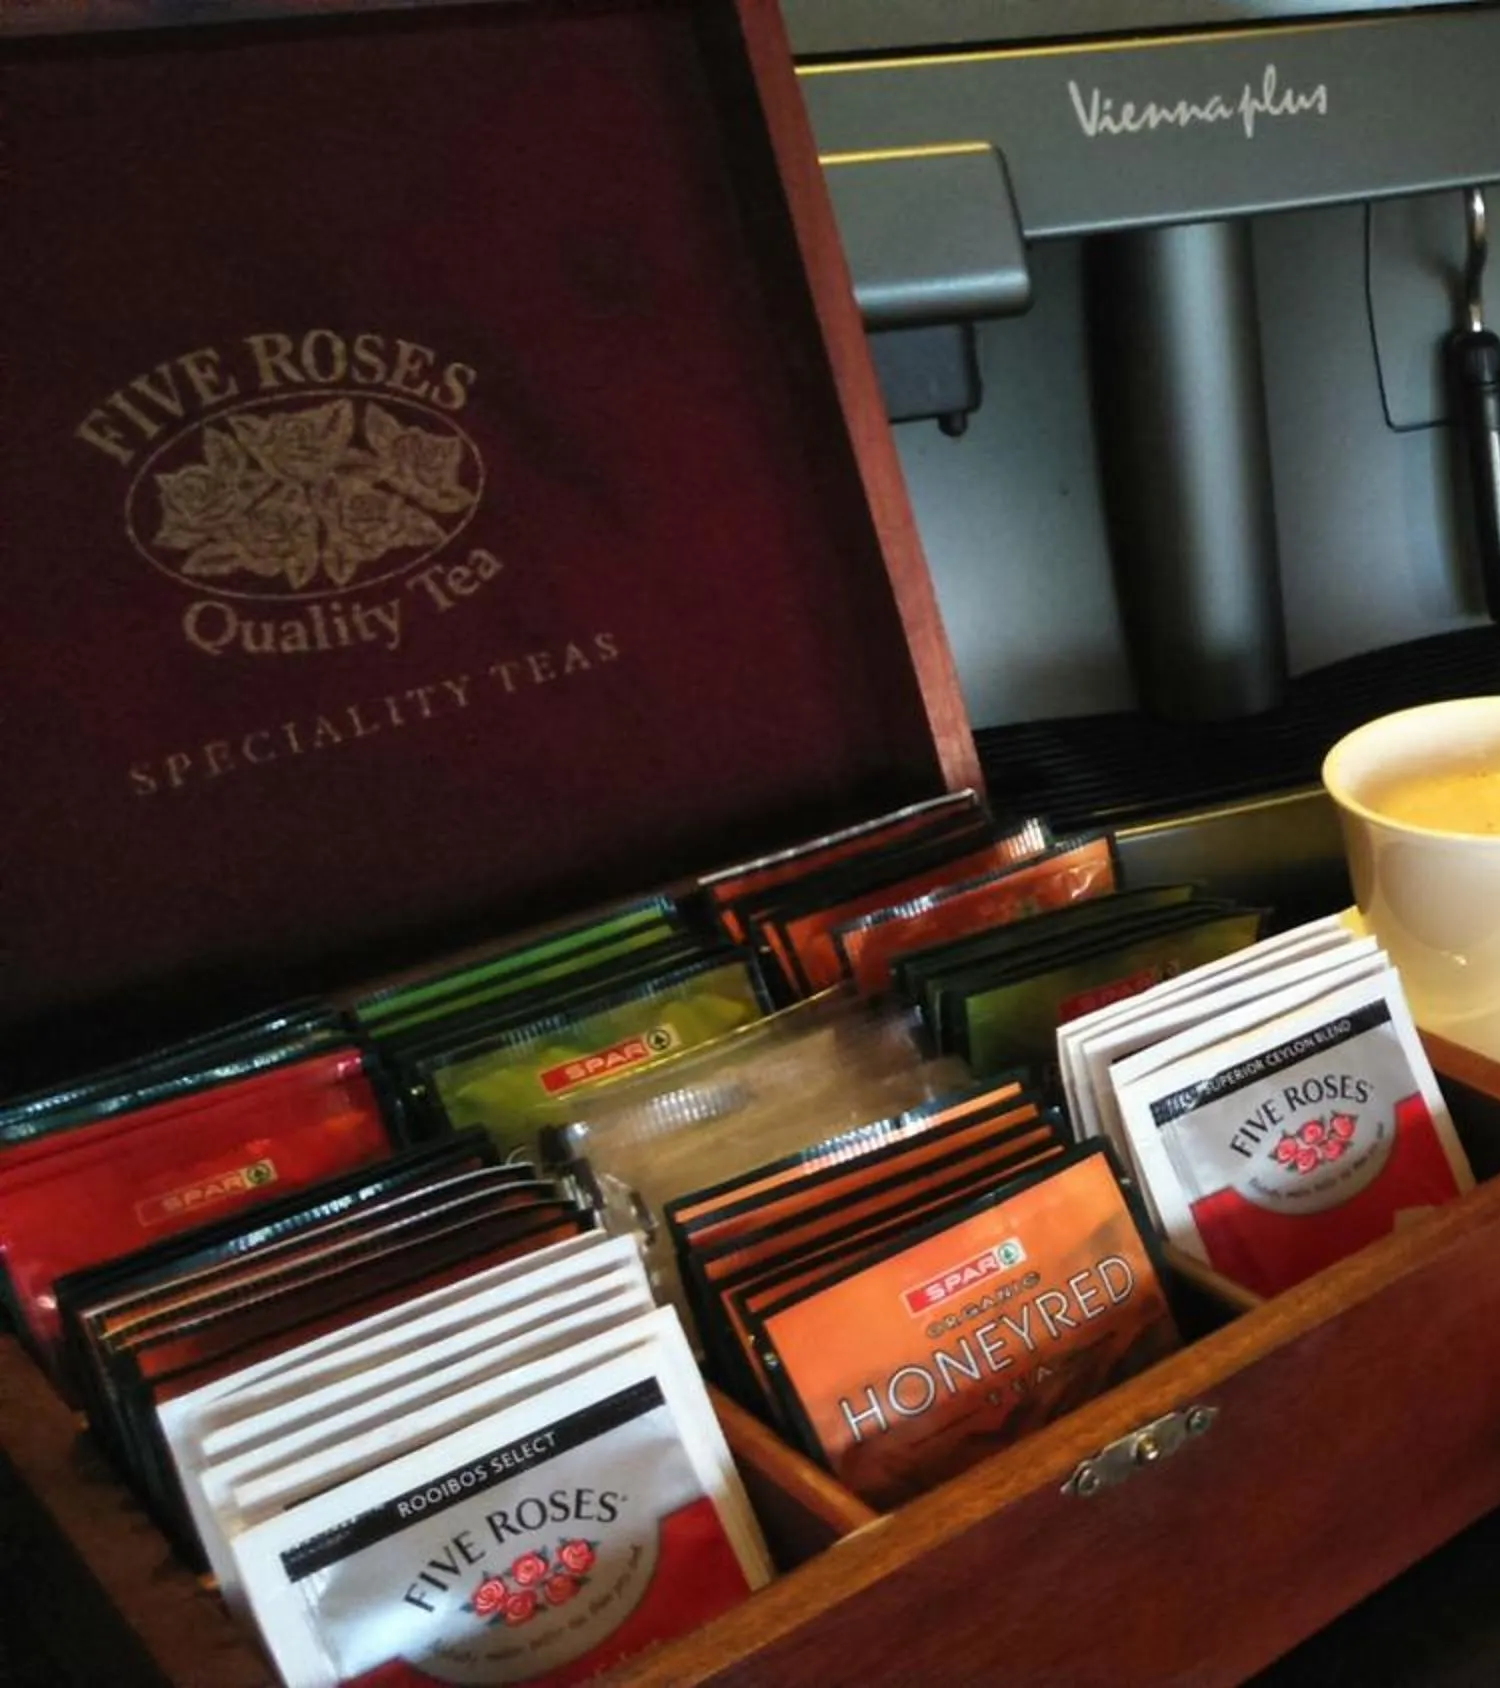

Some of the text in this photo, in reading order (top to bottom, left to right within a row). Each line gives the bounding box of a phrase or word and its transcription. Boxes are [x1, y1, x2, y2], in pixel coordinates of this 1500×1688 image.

[1068, 63, 1328, 139] Vienna plus
[74, 328, 478, 467] FIVE ROSES
[181, 546, 503, 656] Quality Tea
[128, 632, 621, 797] SPECIALITY TEAS
[564, 1043, 646, 1081] SPAR
[1203, 1019, 1352, 1096] SUPERIOR CEYLON BLEND
[1229, 1074, 1370, 1158] FIVE ROSES
[162, 1175, 244, 1212] SPAR
[924, 1253, 998, 1303] SPAR
[926, 1271, 1041, 1339] ORGANIC
[838, 1255, 1137, 1443] HONEYRED
[396, 1431, 558, 1518] ROOIBOS SELECT
[402, 1530, 487, 1613] FIVE
[485, 1487, 619, 1544] ROSES
